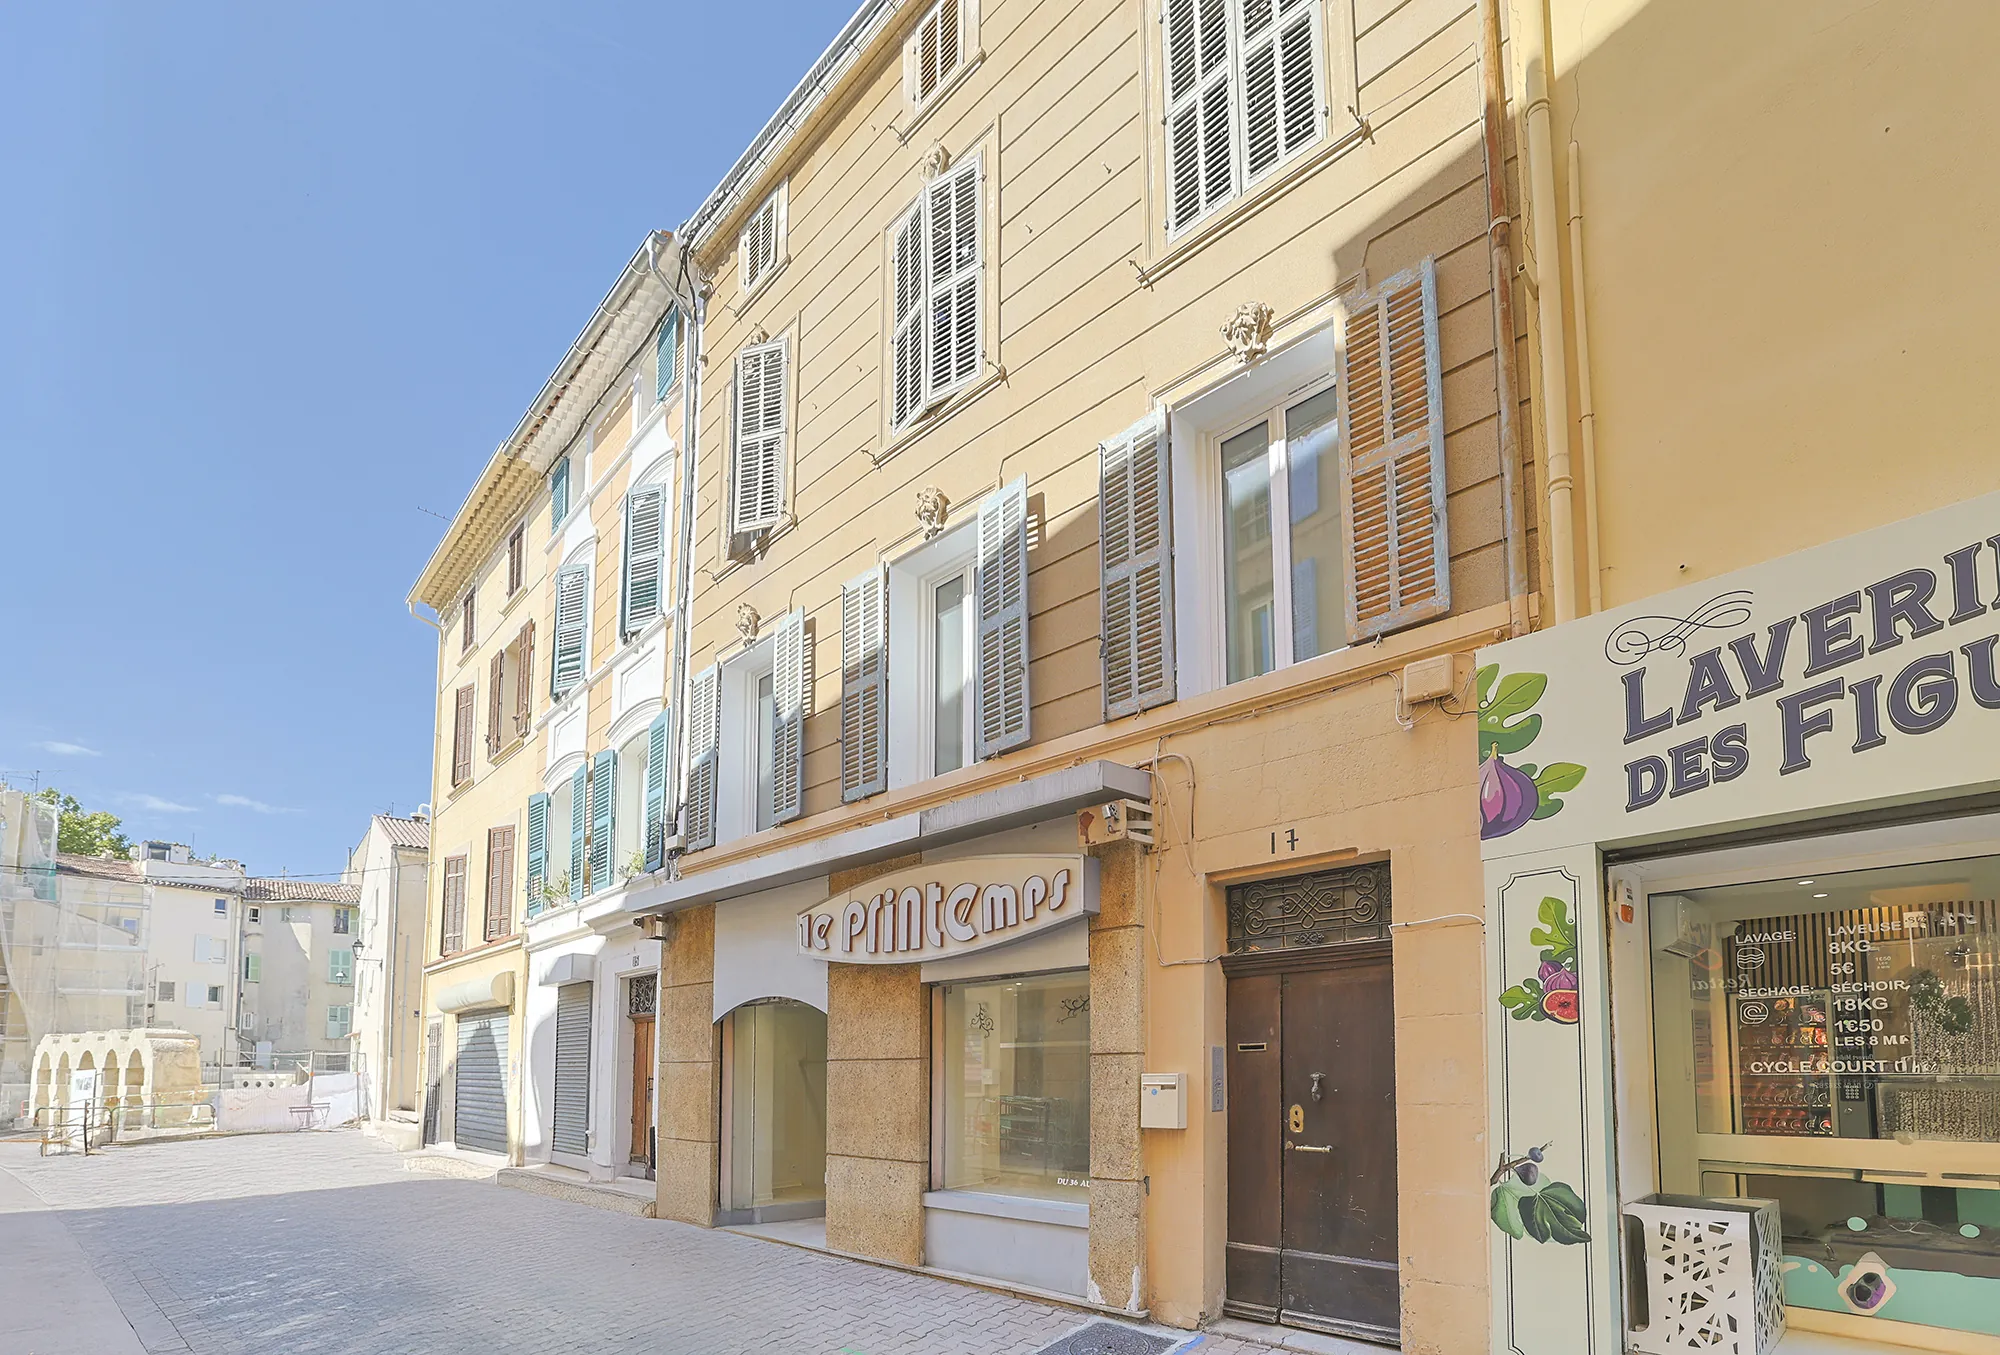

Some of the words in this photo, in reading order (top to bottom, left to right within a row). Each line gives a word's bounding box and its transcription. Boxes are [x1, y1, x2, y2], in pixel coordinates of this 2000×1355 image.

[1624, 722, 1749, 813] DES
[1270, 827, 1300, 855] 17
[1827, 920, 1902, 937] LAVEUSE
[1735, 930, 1797, 944] LAVAGE:
[1828, 939, 1872, 955] 8KG
[1830, 962, 1855, 976] 5€
[1738, 984, 1815, 998] SECHAGE:
[1832, 997, 1889, 1012] 18KG
[1834, 1019, 1884, 1033] 1€50
[1835, 1036, 1867, 1047] LES
[1869, 1035, 1879, 1046] 8
[1750, 1060, 1817, 1073] CYCLE
[1817, 1059, 1889, 1073] COURT
[1057, 1177, 1069, 1186] DU
